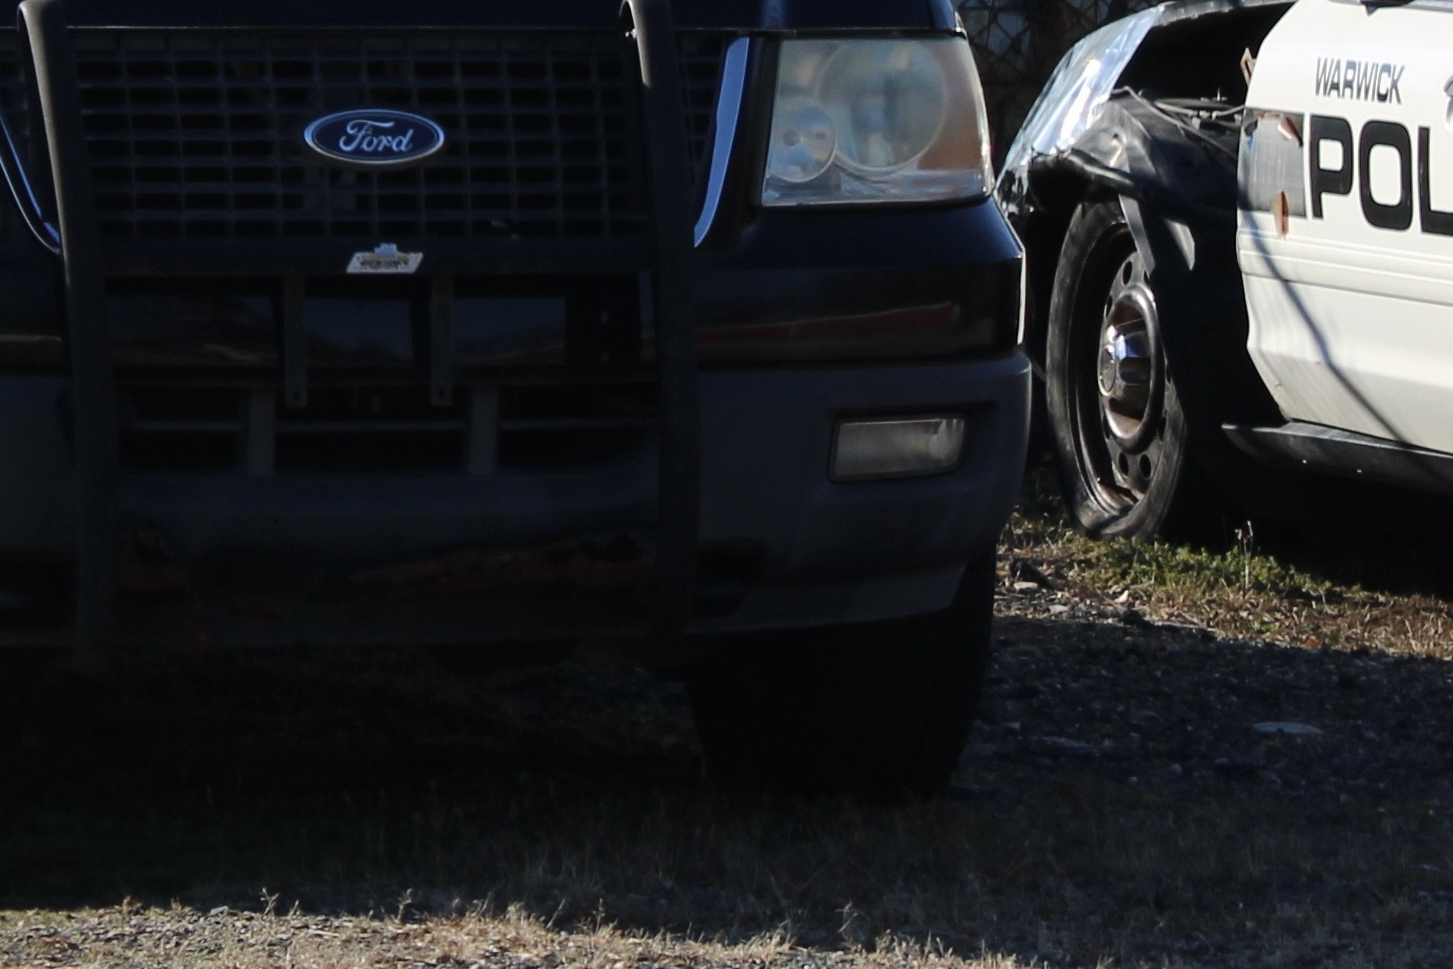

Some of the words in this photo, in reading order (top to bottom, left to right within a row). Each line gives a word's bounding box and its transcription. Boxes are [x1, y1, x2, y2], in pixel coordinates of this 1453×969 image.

[1315, 56, 1406, 105] WARWICK
[339, 119, 414, 152] Ford
[1310, 113, 1453, 237] POL
